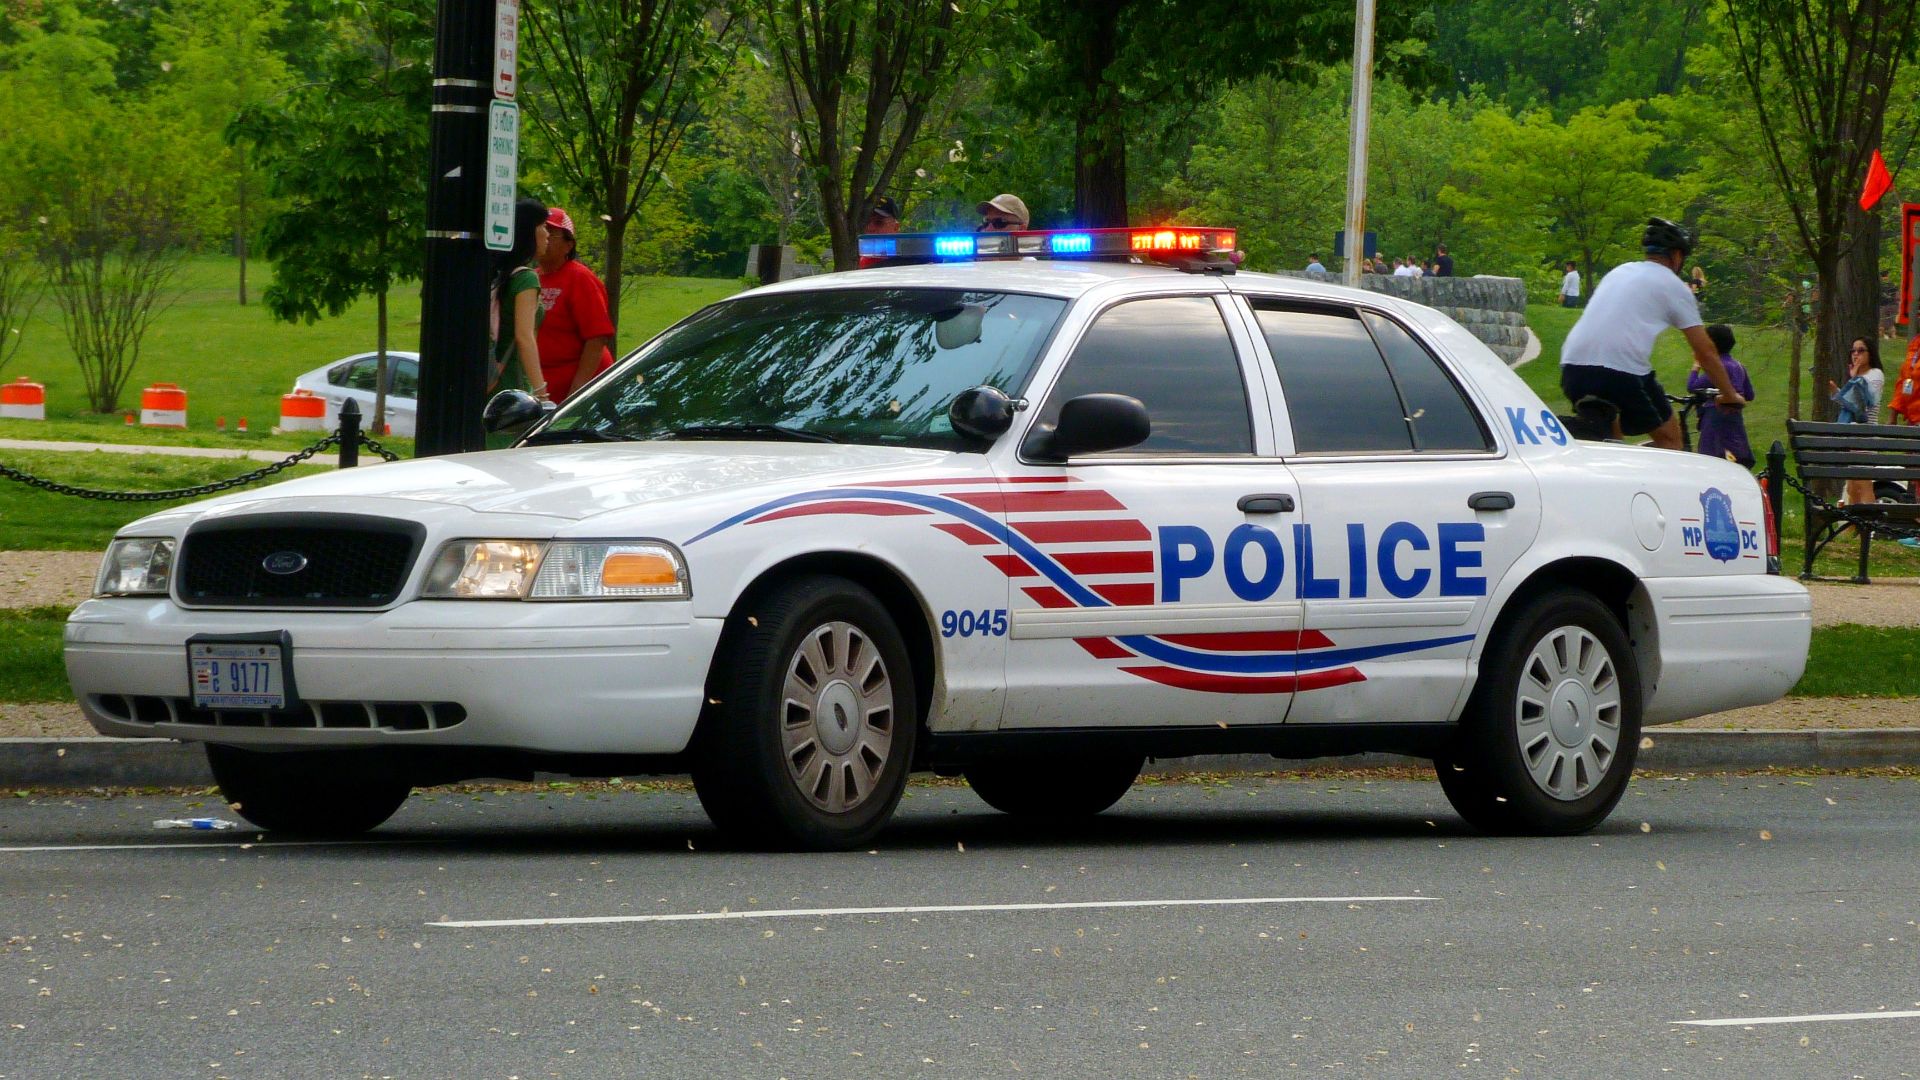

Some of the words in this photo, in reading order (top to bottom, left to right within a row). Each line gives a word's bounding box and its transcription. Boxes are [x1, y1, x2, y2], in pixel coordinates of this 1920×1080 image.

[493, 136, 514, 156] PARKING
[1504, 406, 1567, 446] K-9
[1682, 526, 1703, 547] MP
[1741, 529, 1758, 550] DC
[1158, 521, 1487, 602] POLICE
[941, 609, 1008, 638] 9045
[230, 662, 270, 693] 9177
